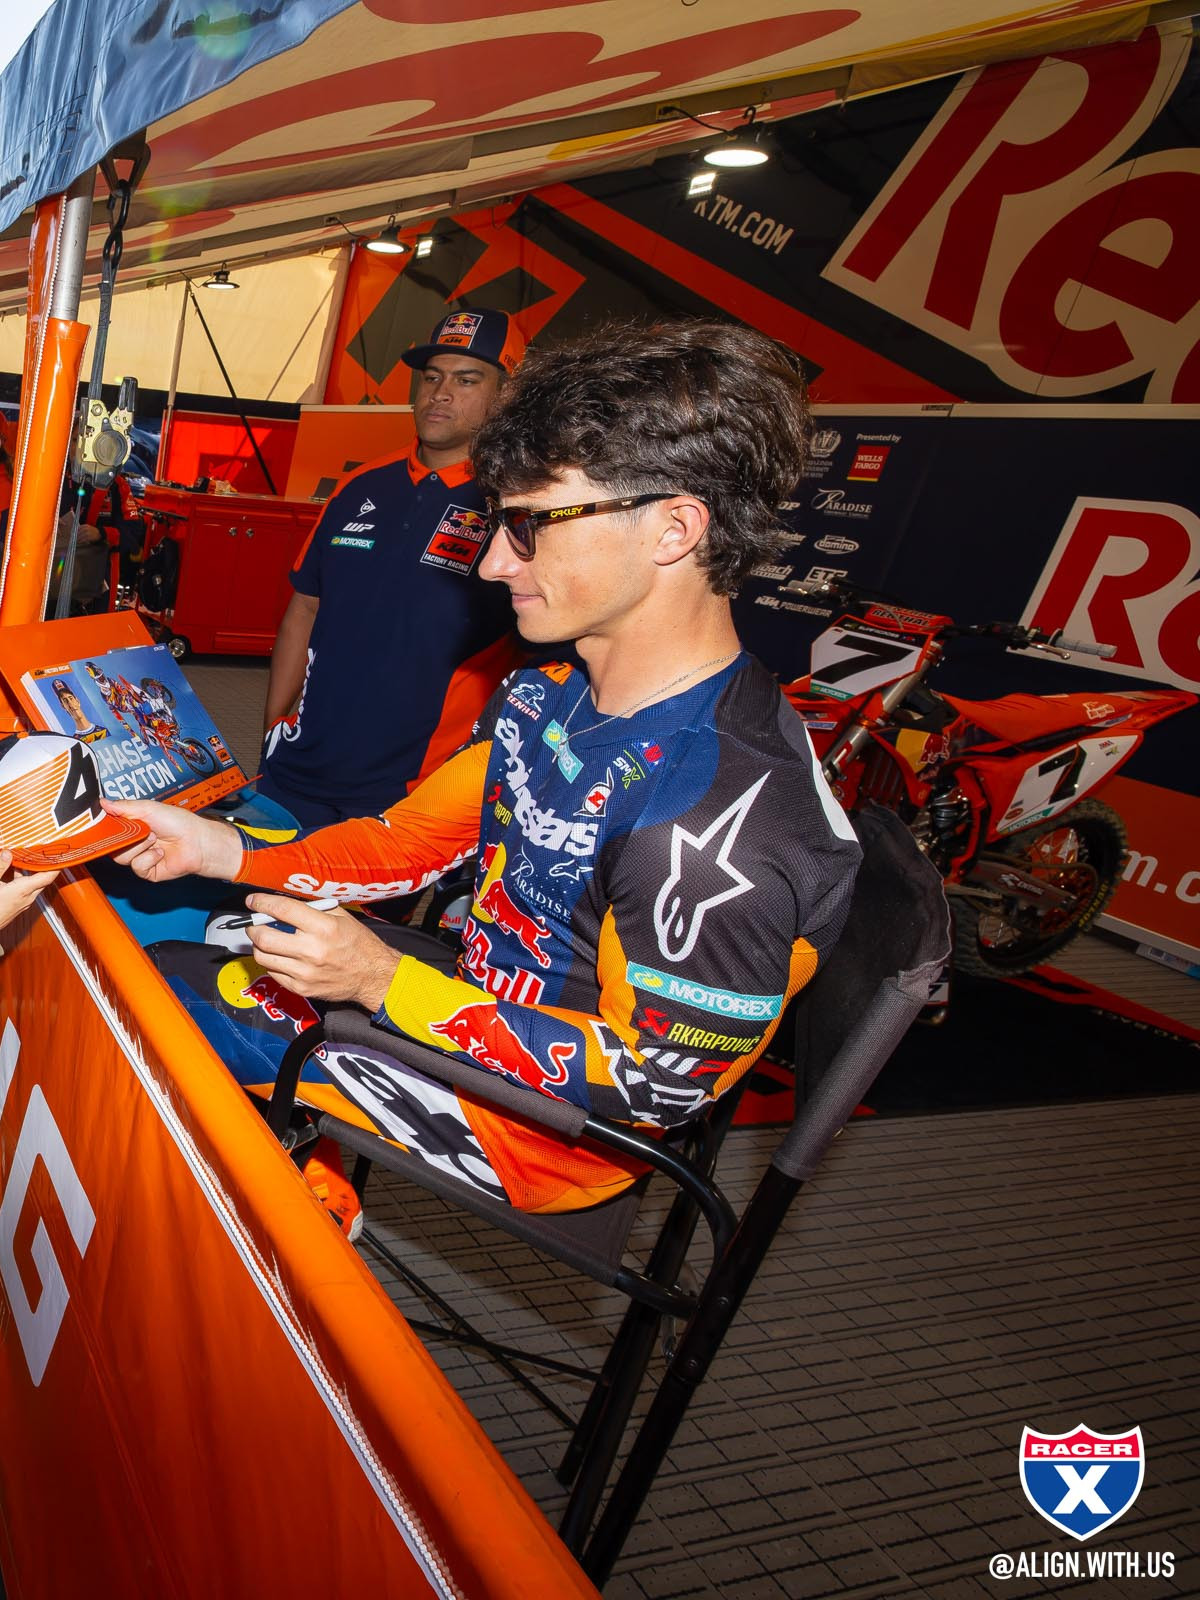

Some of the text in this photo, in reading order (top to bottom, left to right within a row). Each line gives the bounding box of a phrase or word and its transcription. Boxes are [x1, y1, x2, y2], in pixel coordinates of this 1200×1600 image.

[828, 20, 1200, 403] Re
[856, 433, 901, 443] Presented by
[854, 462, 881, 470] FARGO
[857, 454, 883, 462] WELLS
[811, 488, 873, 513] PARADISE
[550, 506, 584, 519] OAKLEY
[342, 522, 376, 533] WP
[440, 520, 488, 542] Red Bull
[338, 536, 373, 549] MOTOREX
[436, 541, 474, 557] KTM
[818, 539, 855, 551] domino
[424, 553, 470, 572] FACTORY RACING
[780, 601, 833, 618] POWERWEAR
[811, 634, 916, 685] 7
[103, 758, 177, 801] SEXTON
[1037, 744, 1088, 805] 7
[52, 741, 103, 828] 4
[667, 979, 774, 1017] MOTOREX
